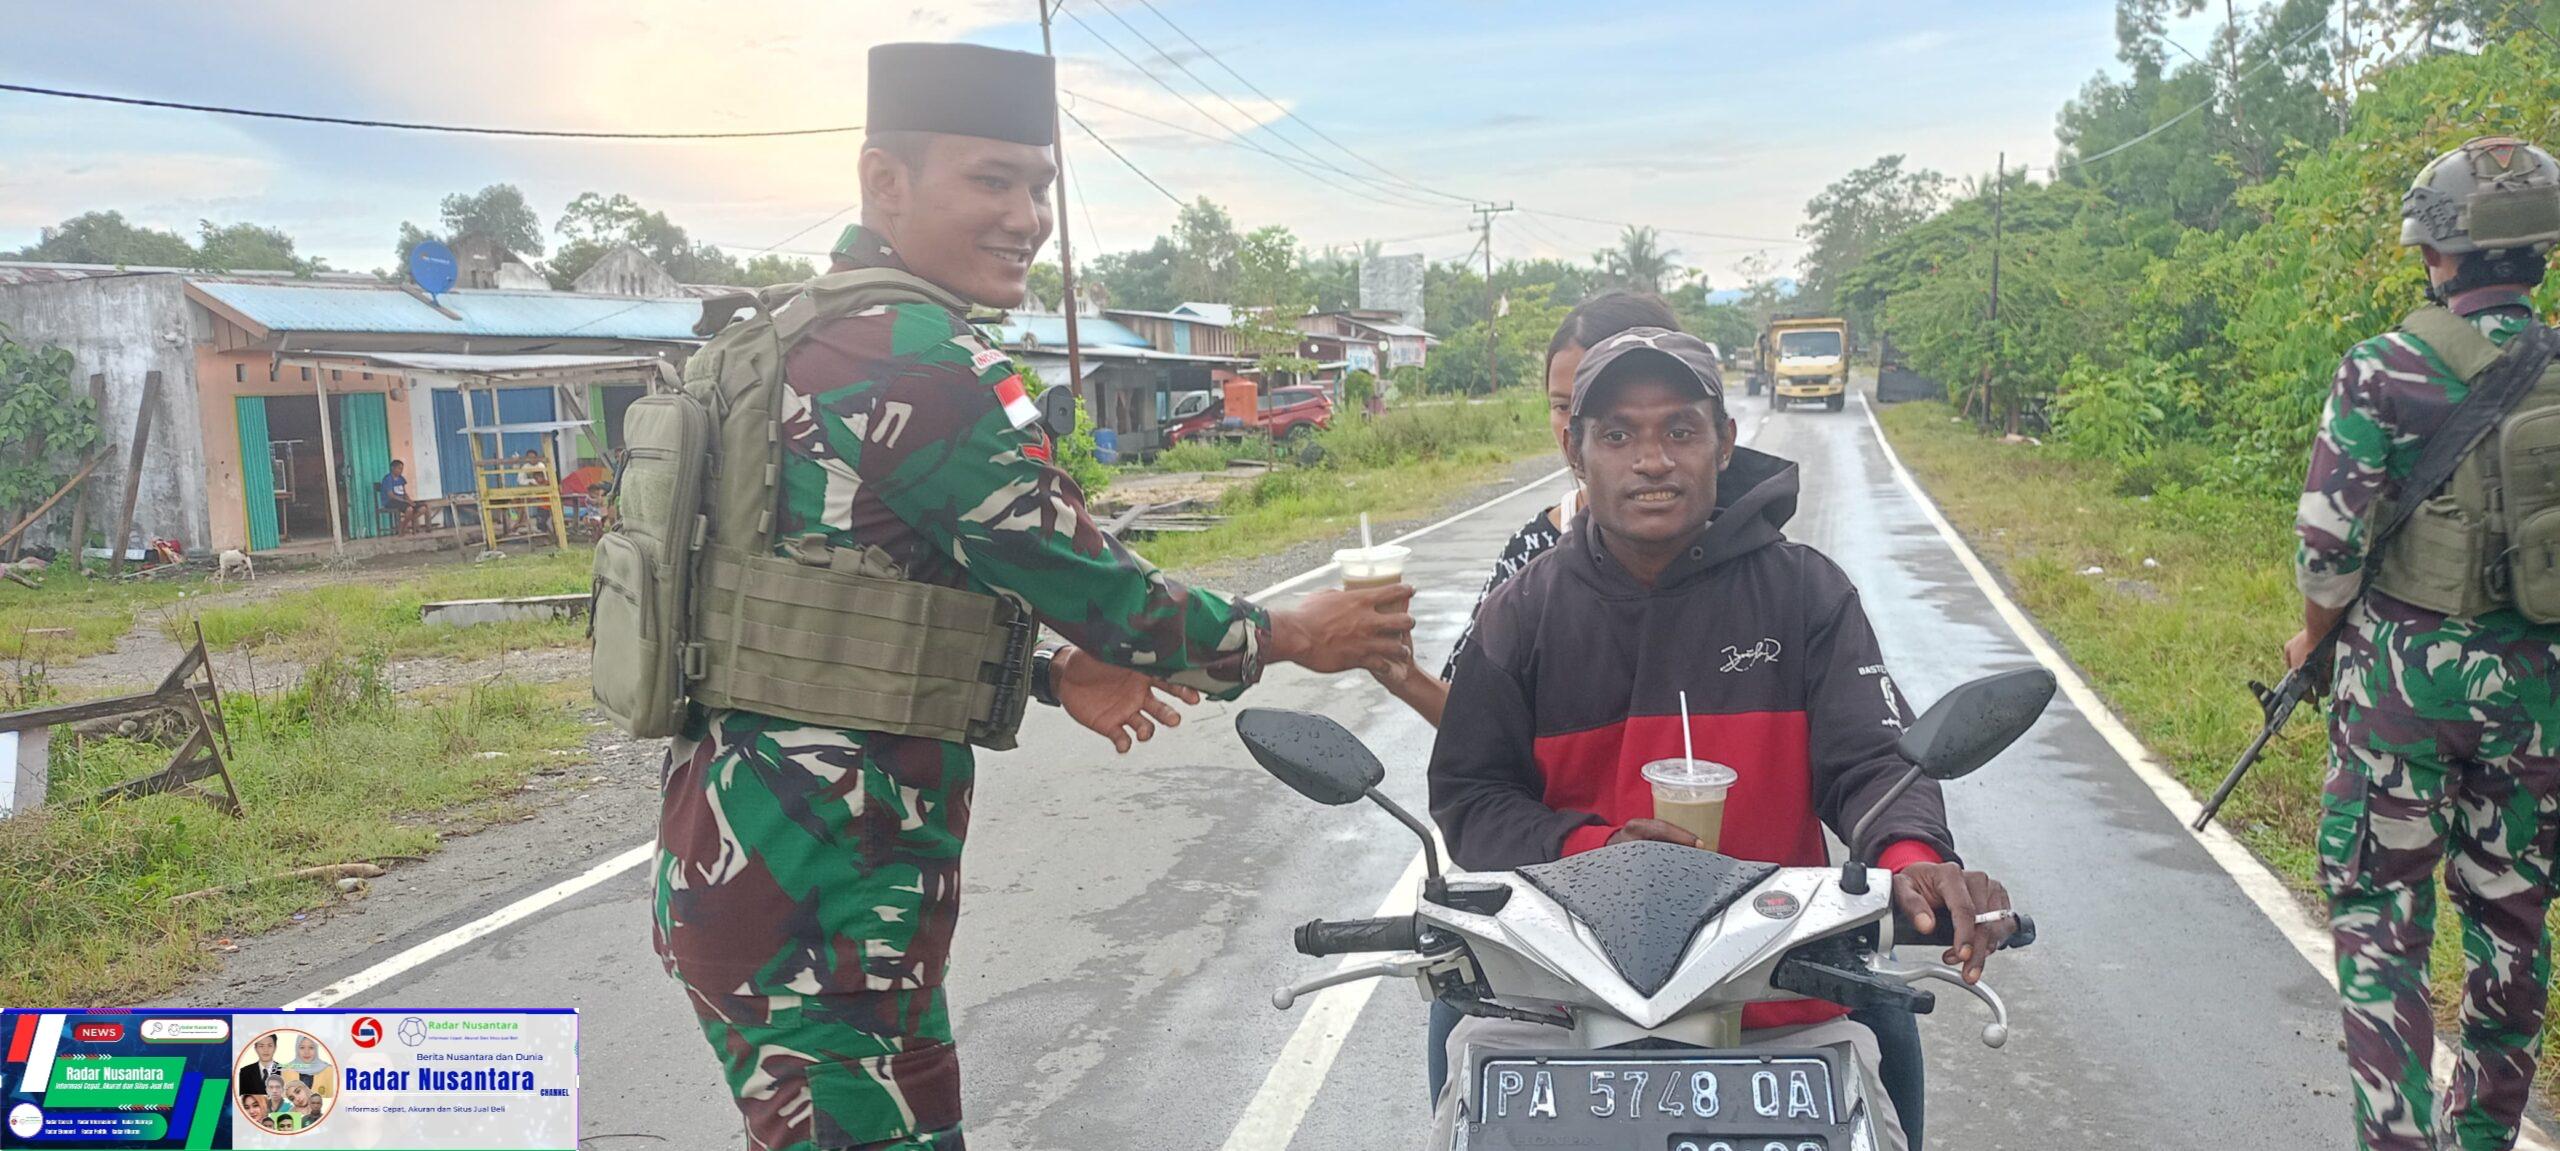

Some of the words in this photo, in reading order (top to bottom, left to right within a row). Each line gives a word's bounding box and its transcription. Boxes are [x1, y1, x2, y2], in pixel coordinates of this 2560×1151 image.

[1524, 531, 1555, 550] NY
[1497, 1071, 1559, 1119] PA
[1589, 1071, 1720, 1119] 5748
